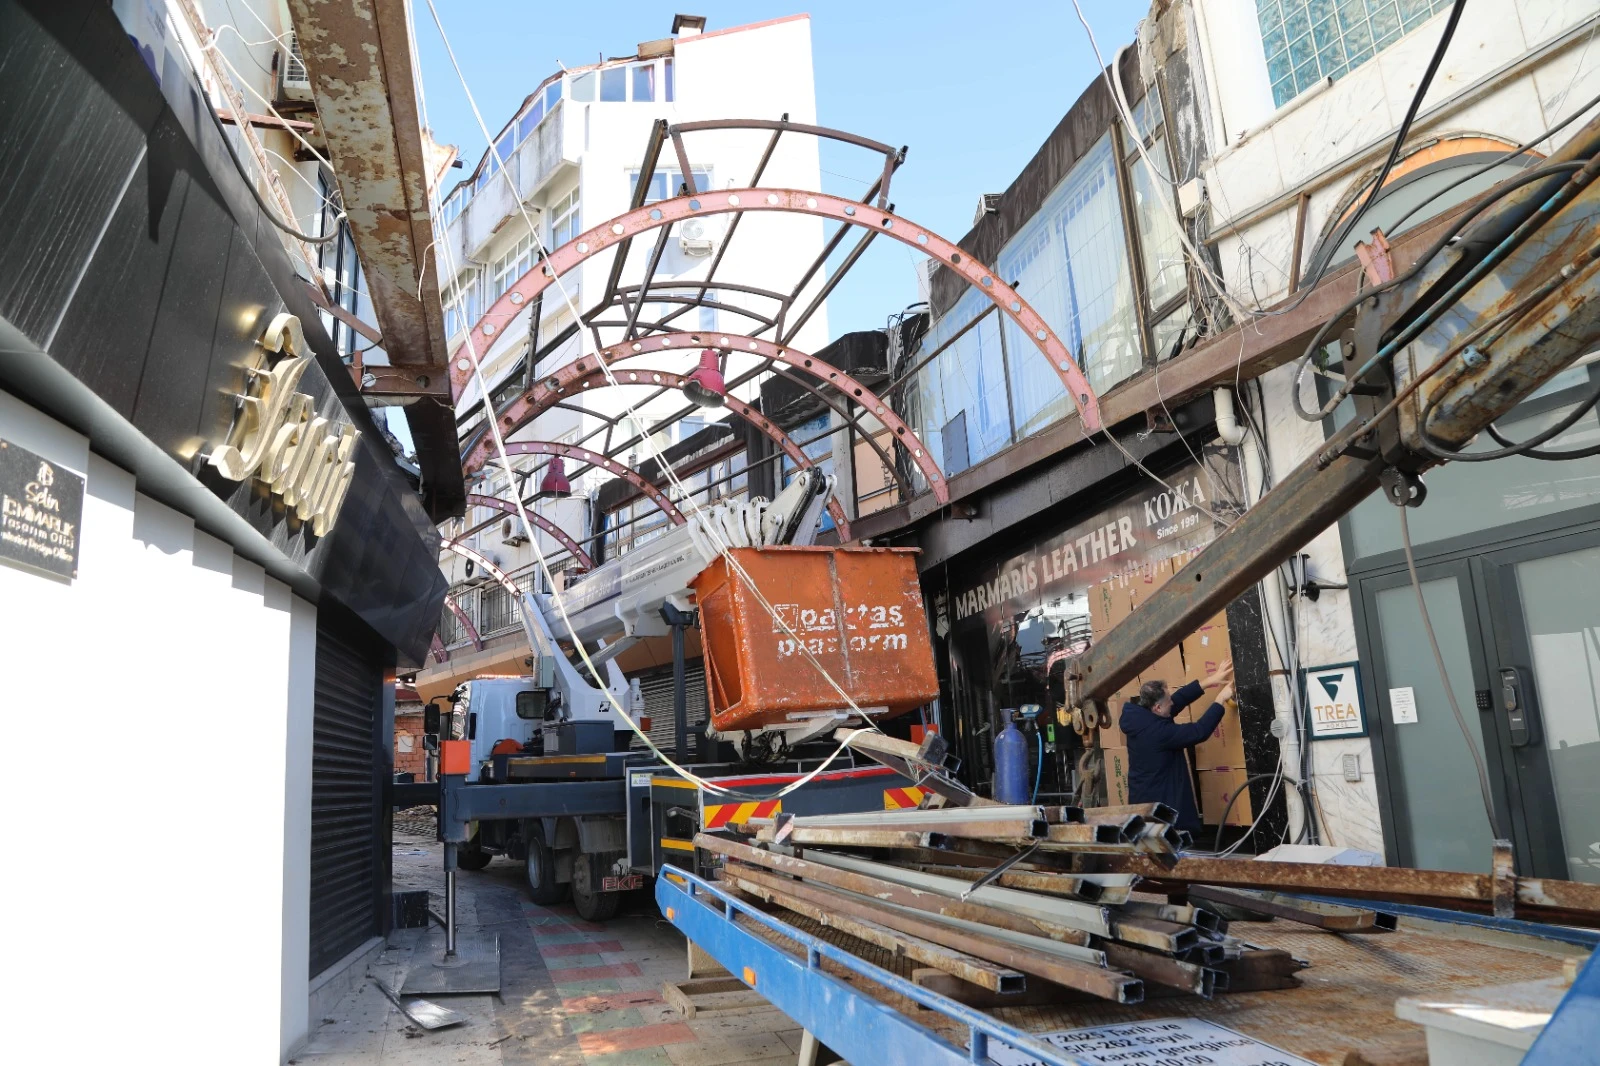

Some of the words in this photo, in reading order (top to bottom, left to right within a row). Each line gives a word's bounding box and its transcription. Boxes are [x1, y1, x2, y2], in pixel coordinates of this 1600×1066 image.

[1157, 523, 1179, 540] Since
[1180, 511, 1199, 530] 1991
[955, 562, 1038, 621] MARMARIS
[1041, 515, 1137, 584] LEATHER
[1313, 703, 1357, 721] TREA
